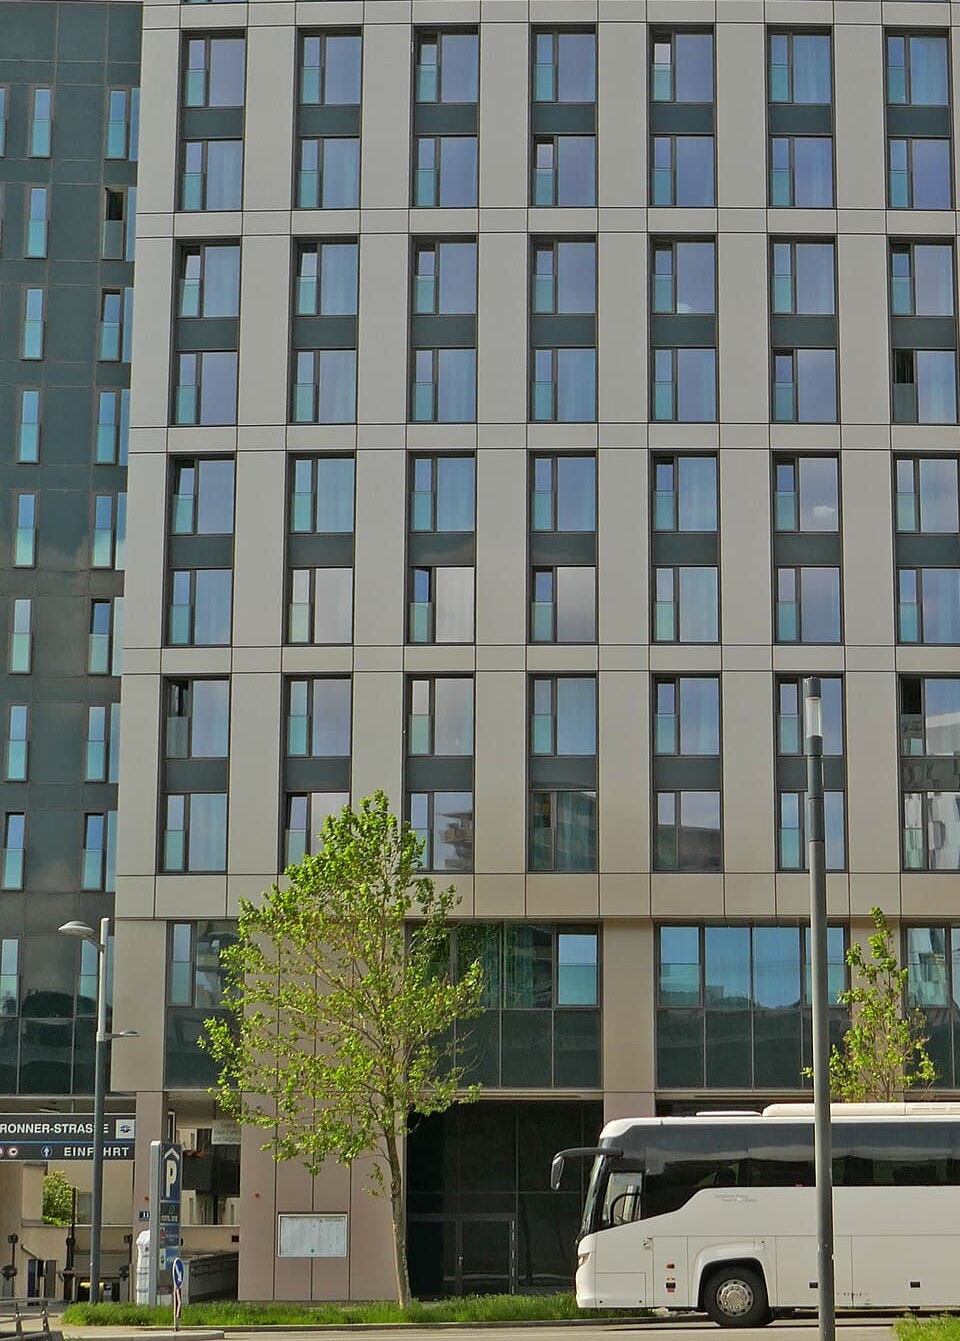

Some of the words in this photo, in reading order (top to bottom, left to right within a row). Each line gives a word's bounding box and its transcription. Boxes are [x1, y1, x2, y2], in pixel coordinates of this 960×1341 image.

[0, 1123, 109, 1134] RONNER-STRASE
[63, 1146, 130, 1157] EINFHRT
[166, 1159, 178, 1198] P
